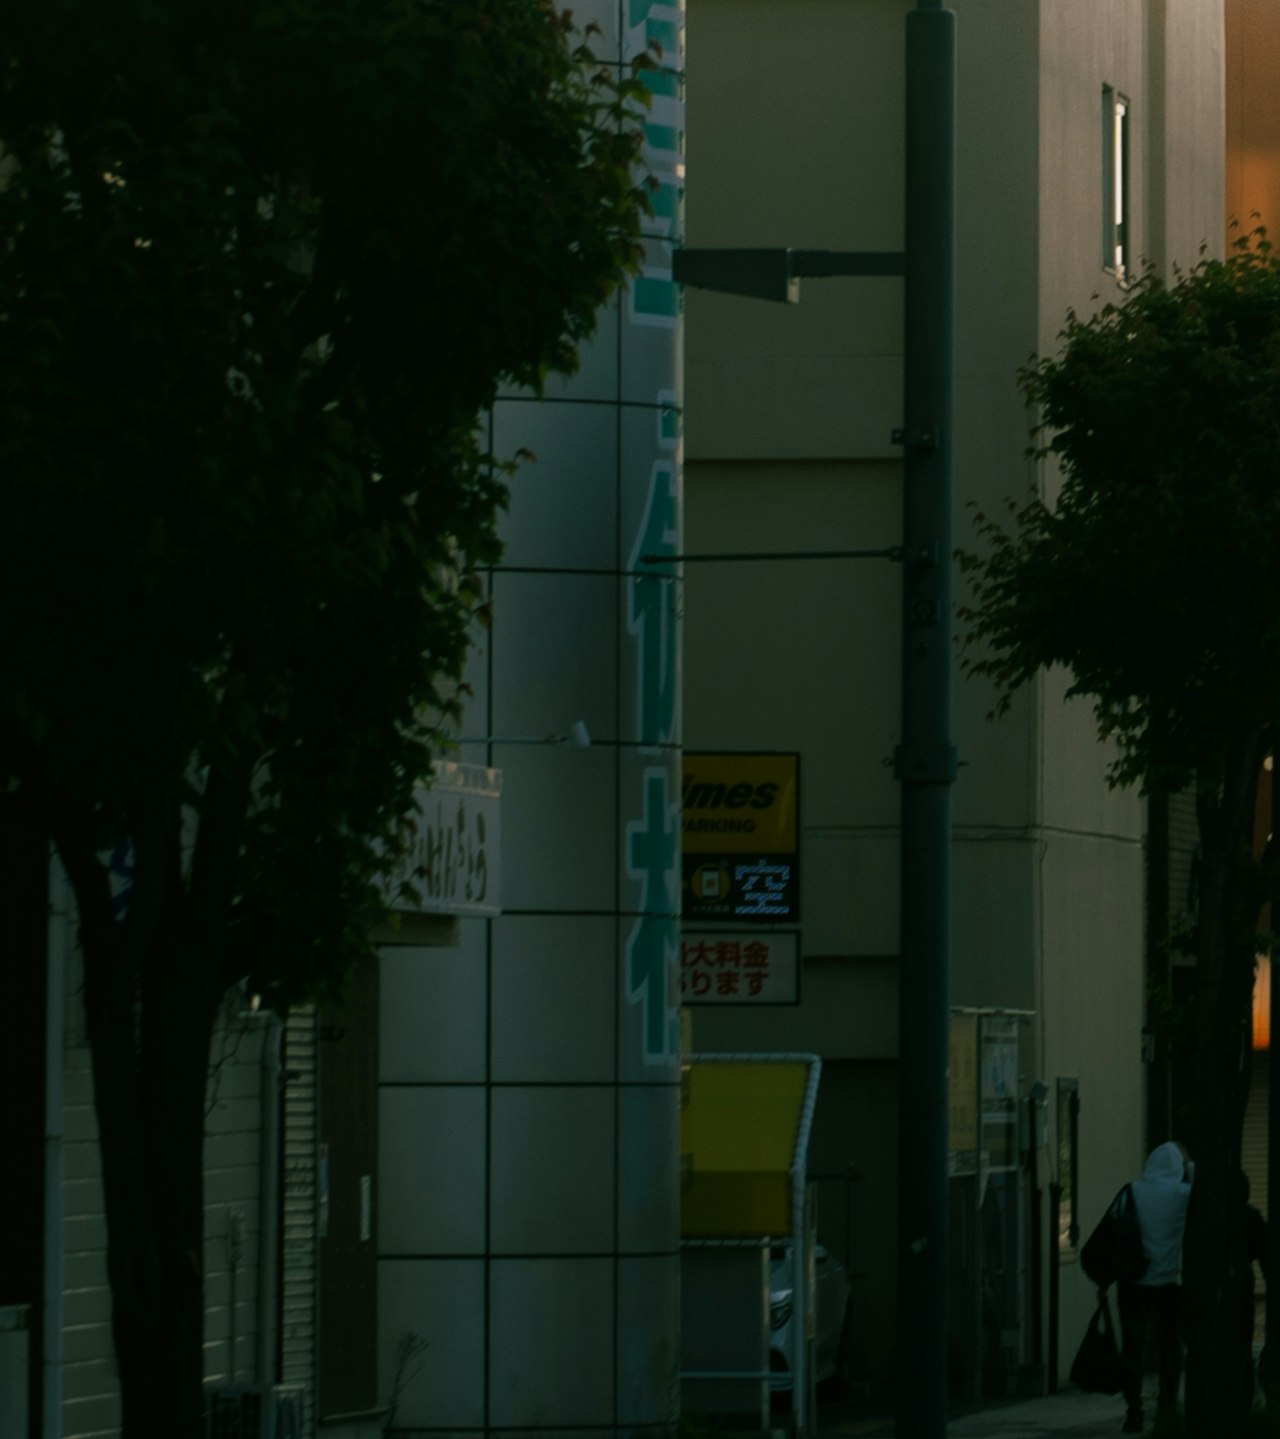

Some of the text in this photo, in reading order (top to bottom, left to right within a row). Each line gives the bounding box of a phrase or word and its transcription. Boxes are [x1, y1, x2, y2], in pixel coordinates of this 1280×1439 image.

[681, 774, 779, 810] imes
[683, 818, 756, 832] ARKING
[734, 858, 791, 915] 空
